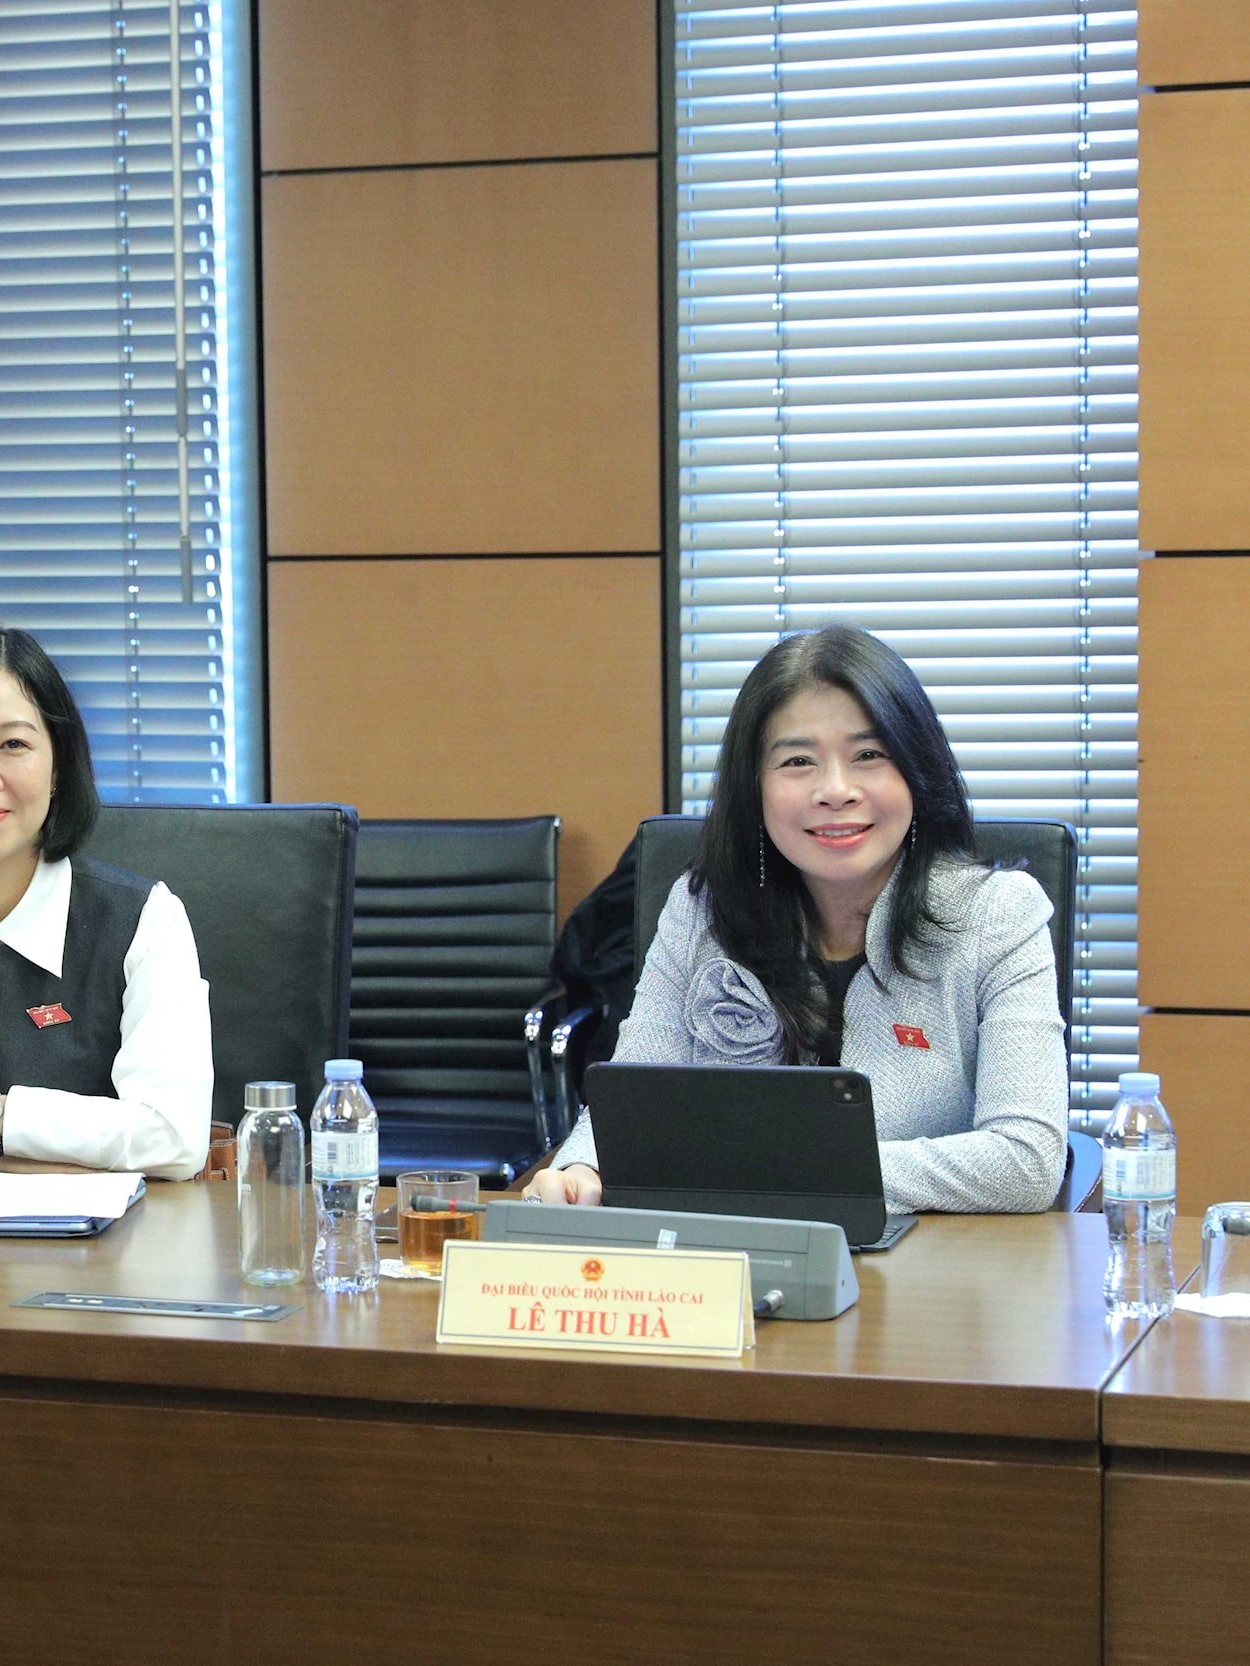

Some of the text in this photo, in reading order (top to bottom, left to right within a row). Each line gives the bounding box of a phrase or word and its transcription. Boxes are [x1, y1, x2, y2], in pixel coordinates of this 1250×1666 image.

[481, 1283, 504, 1297] ĐẠI
[541, 1284, 581, 1299] QUỐC
[584, 1287, 608, 1302] HỘI
[648, 1288, 676, 1303] LÀO
[679, 1292, 704, 1305] CAI
[508, 1301, 670, 1338] LÊ THU HÀ
